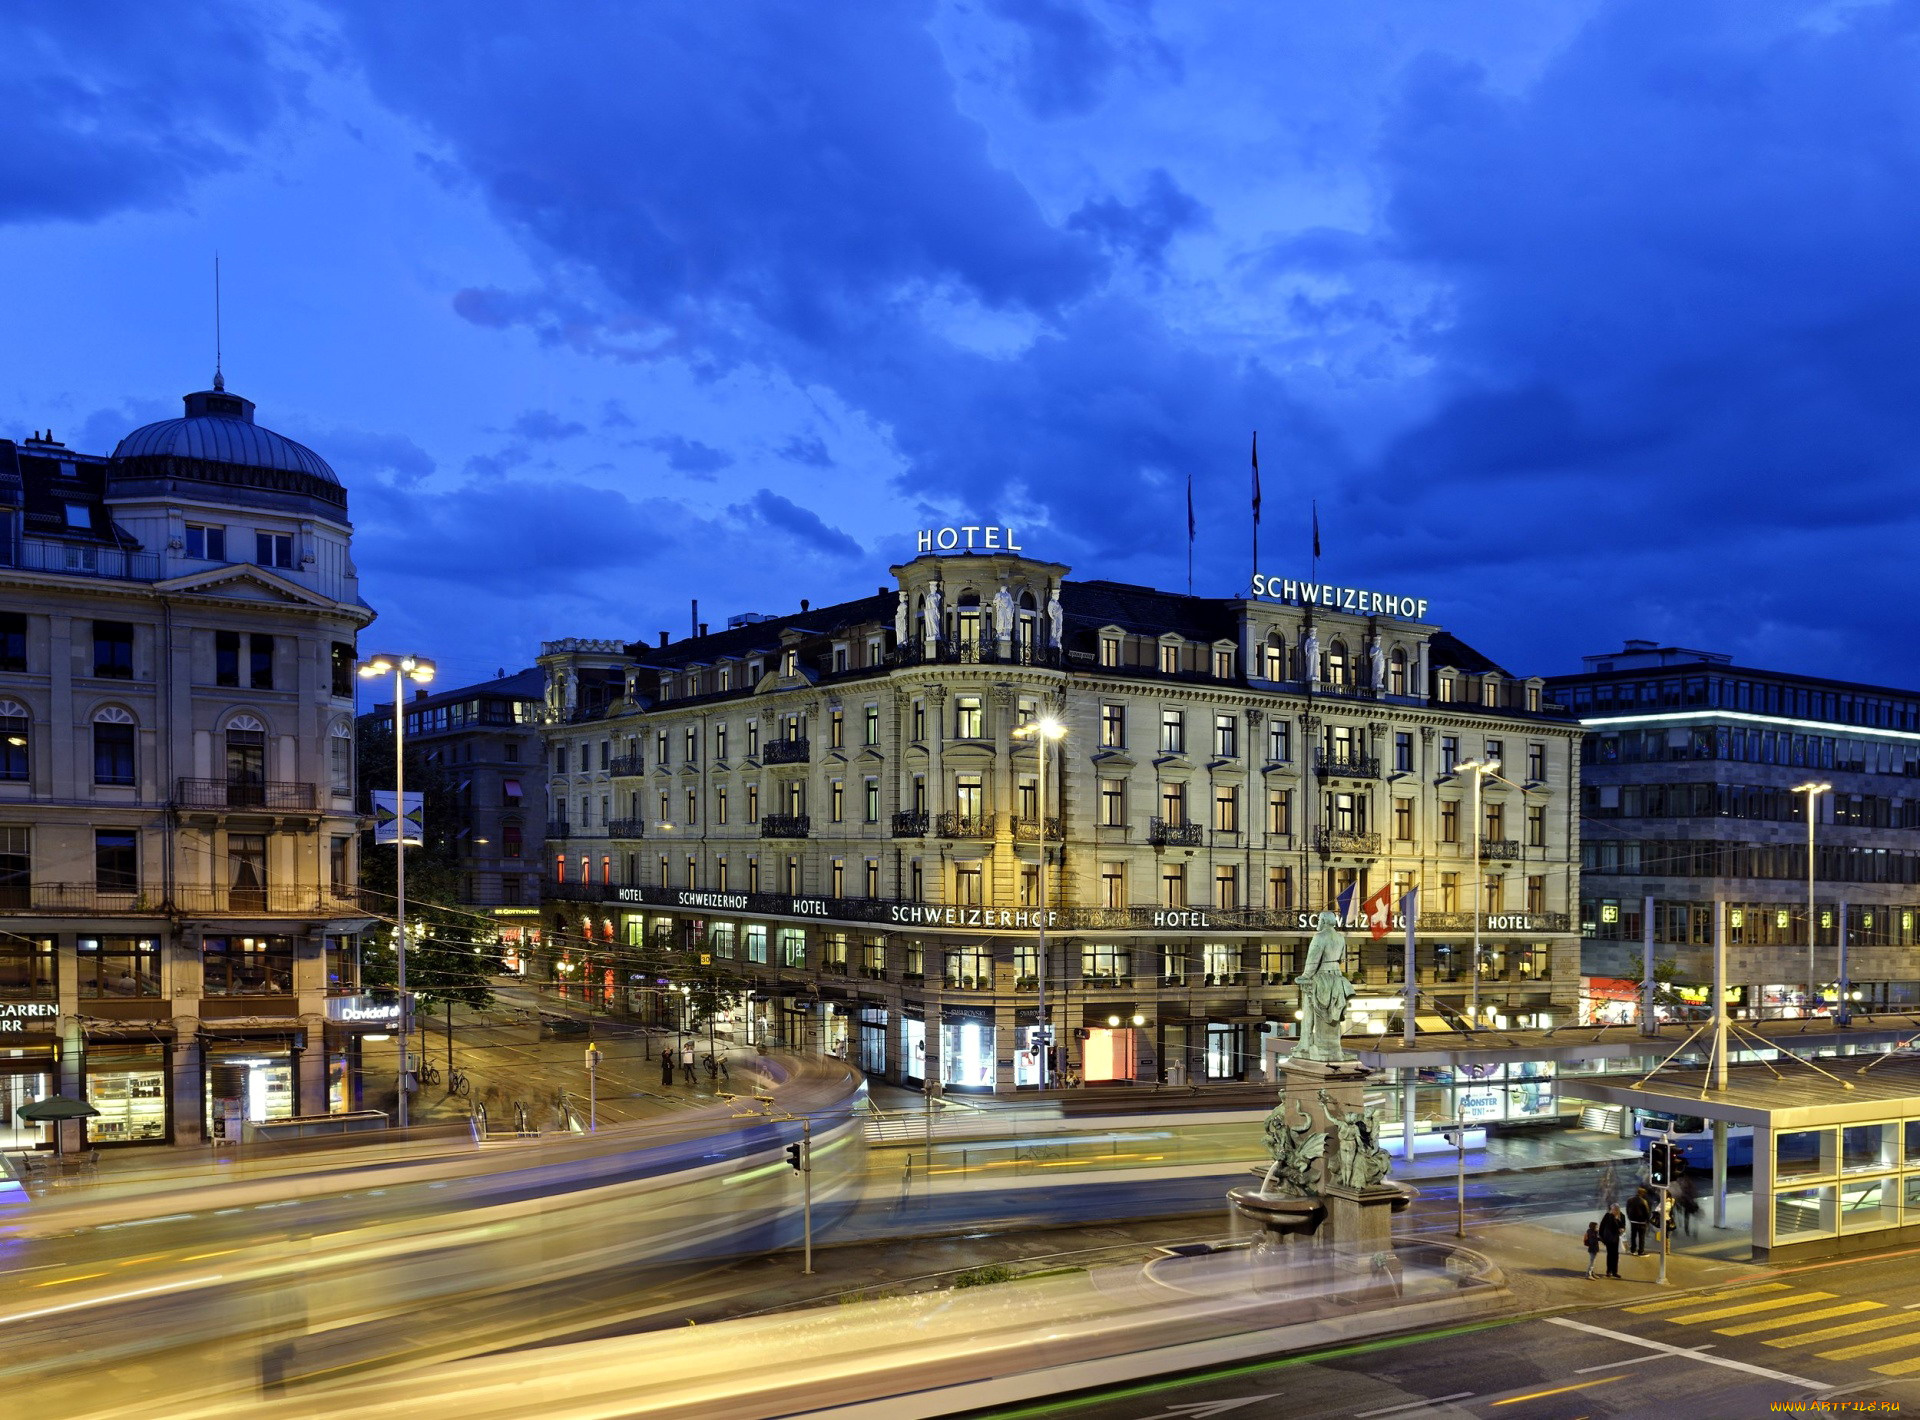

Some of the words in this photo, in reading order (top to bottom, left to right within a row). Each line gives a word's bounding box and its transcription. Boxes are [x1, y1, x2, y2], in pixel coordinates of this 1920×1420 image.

[918, 527, 1022, 552] HOTEL
[1253, 574, 1428, 618] SCHWEIZERHOF
[619, 889, 643, 902] HOTEL
[679, 892, 748, 909] SCHWEIZERHOF
[793, 900, 829, 915] HOTEL
[891, 905, 1057, 927] SCHWEIZERHOF
[1154, 911, 1209, 926] HOTEL
[1488, 916, 1532, 930] HOTEL
[1460, 1097, 1497, 1107] MONSTER
